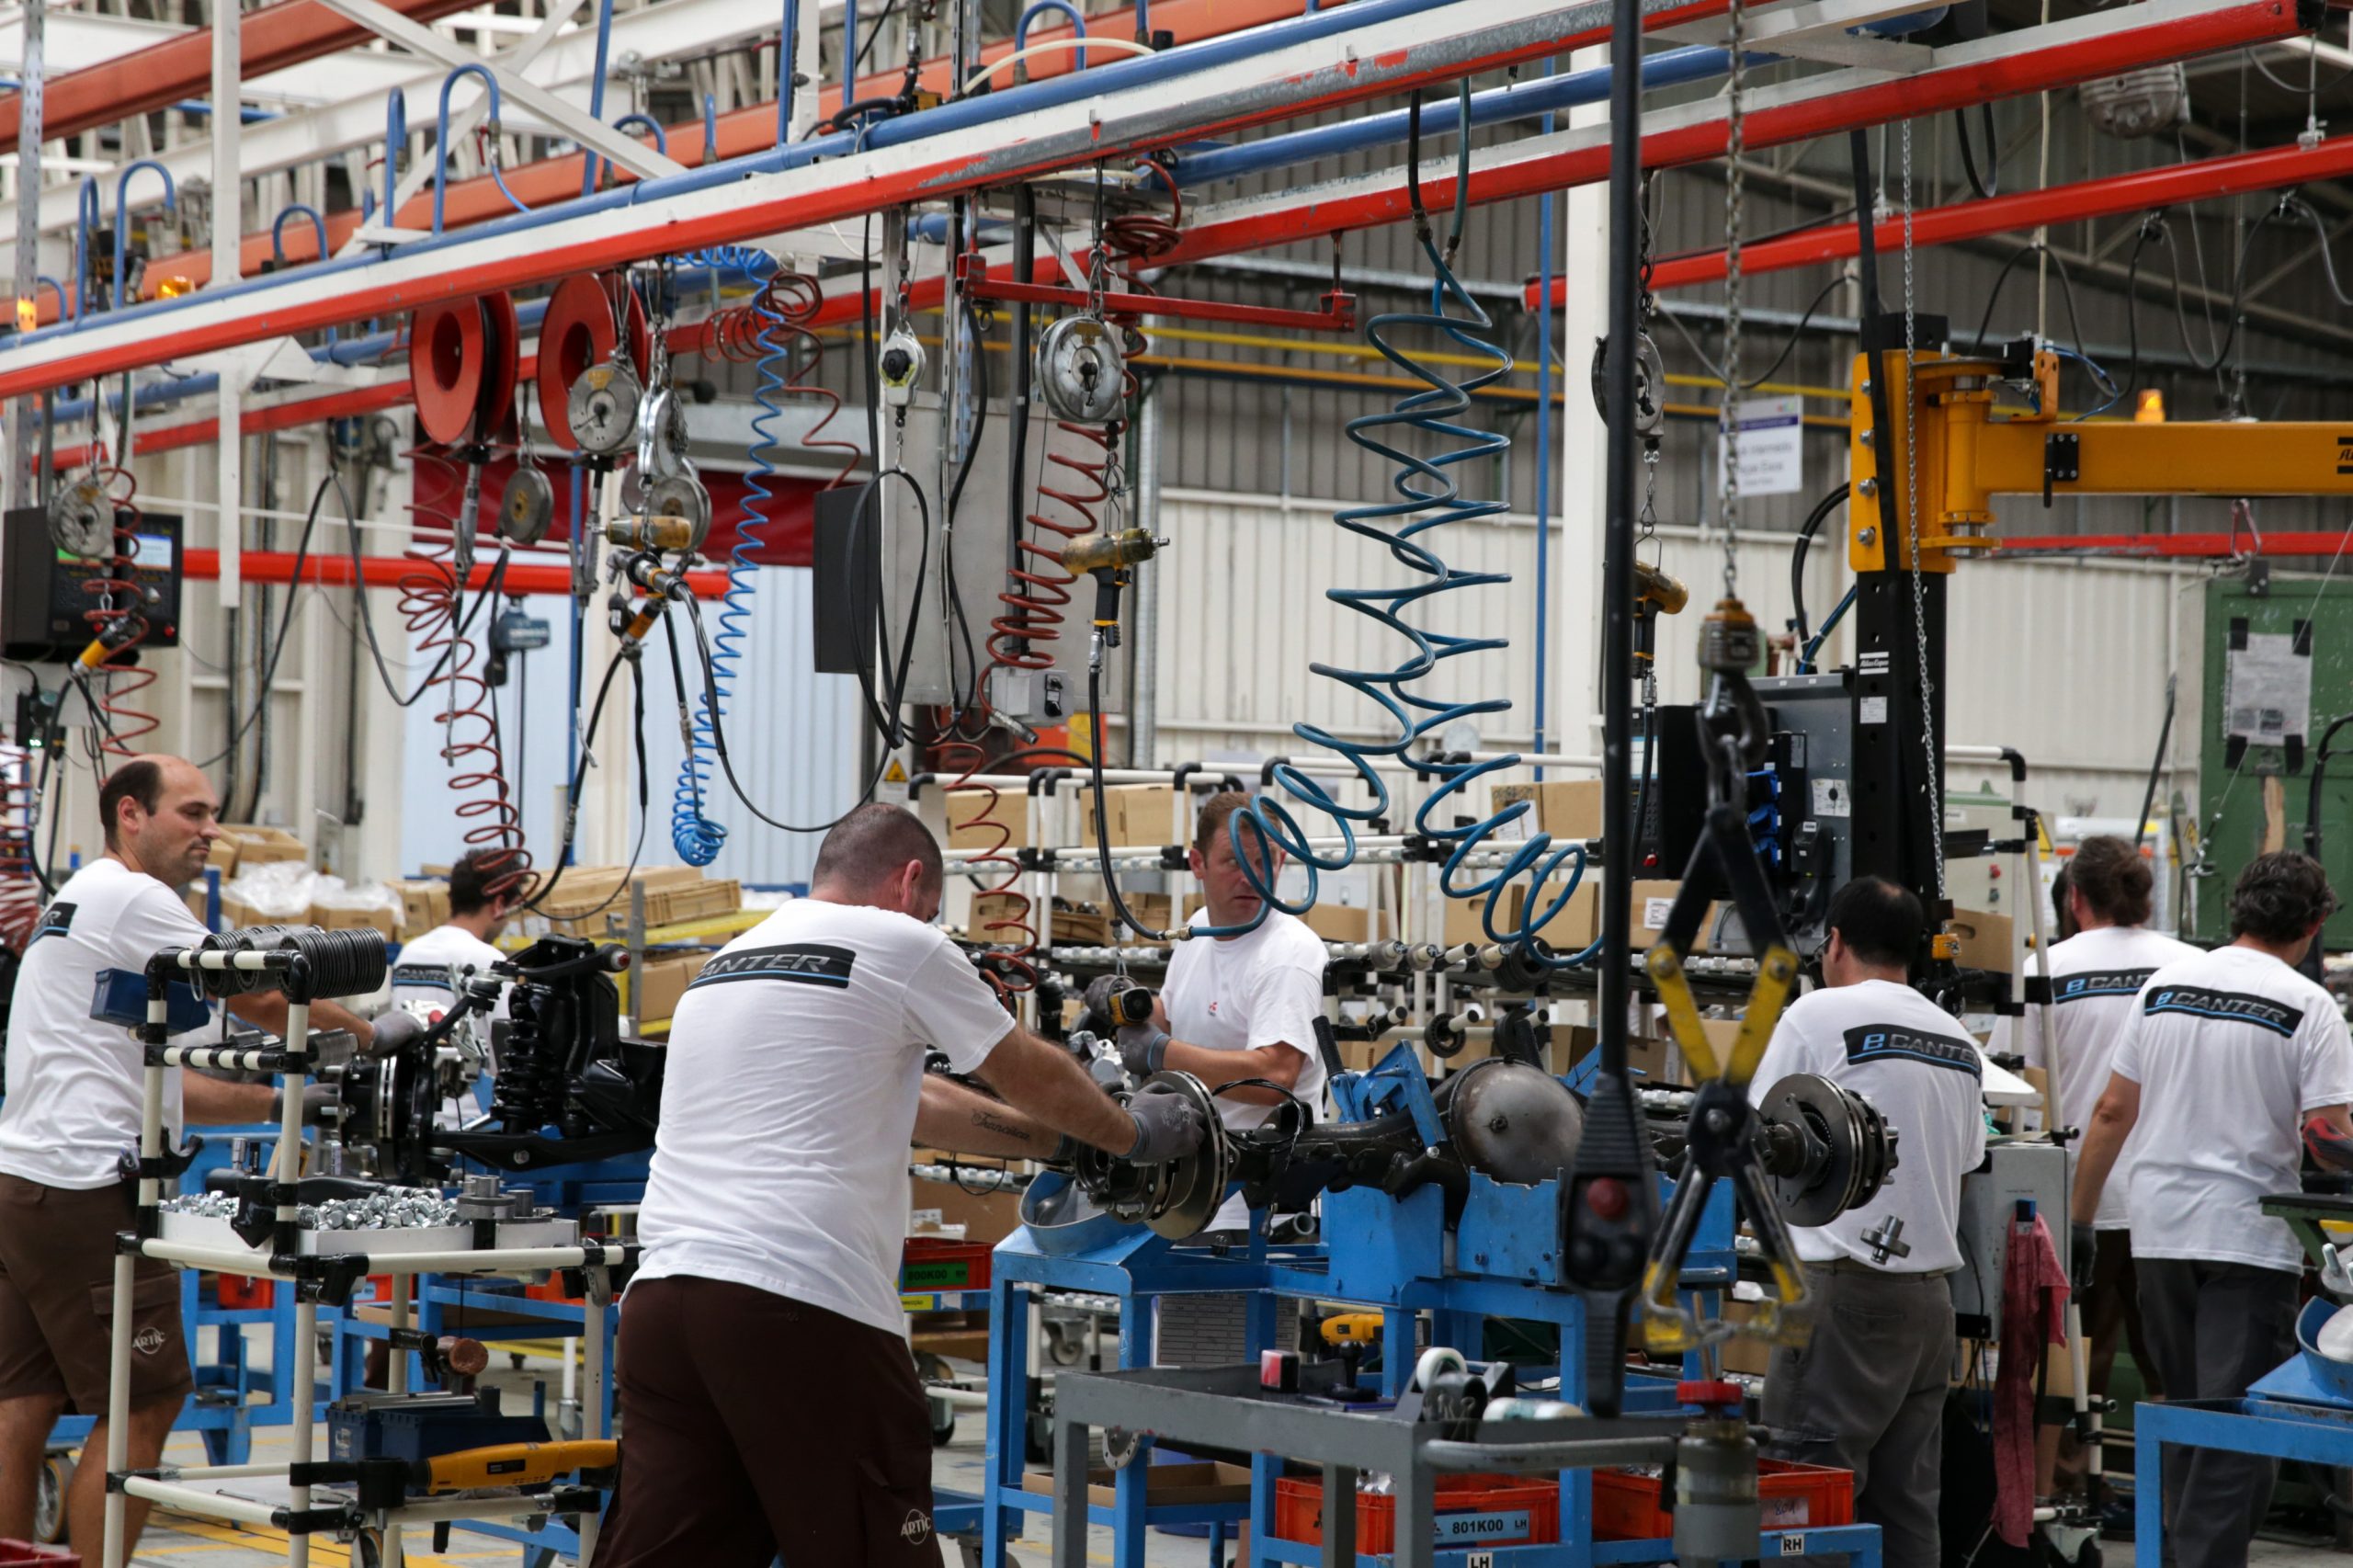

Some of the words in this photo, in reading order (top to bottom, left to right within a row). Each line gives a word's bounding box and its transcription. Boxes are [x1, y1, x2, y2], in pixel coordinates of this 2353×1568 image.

[1452, 1519, 1504, 1535] 801K00
[1515, 1519, 1527, 1528] LH
[1783, 1538, 1802, 1551] RH
[1471, 1556, 1489, 1568] LH
